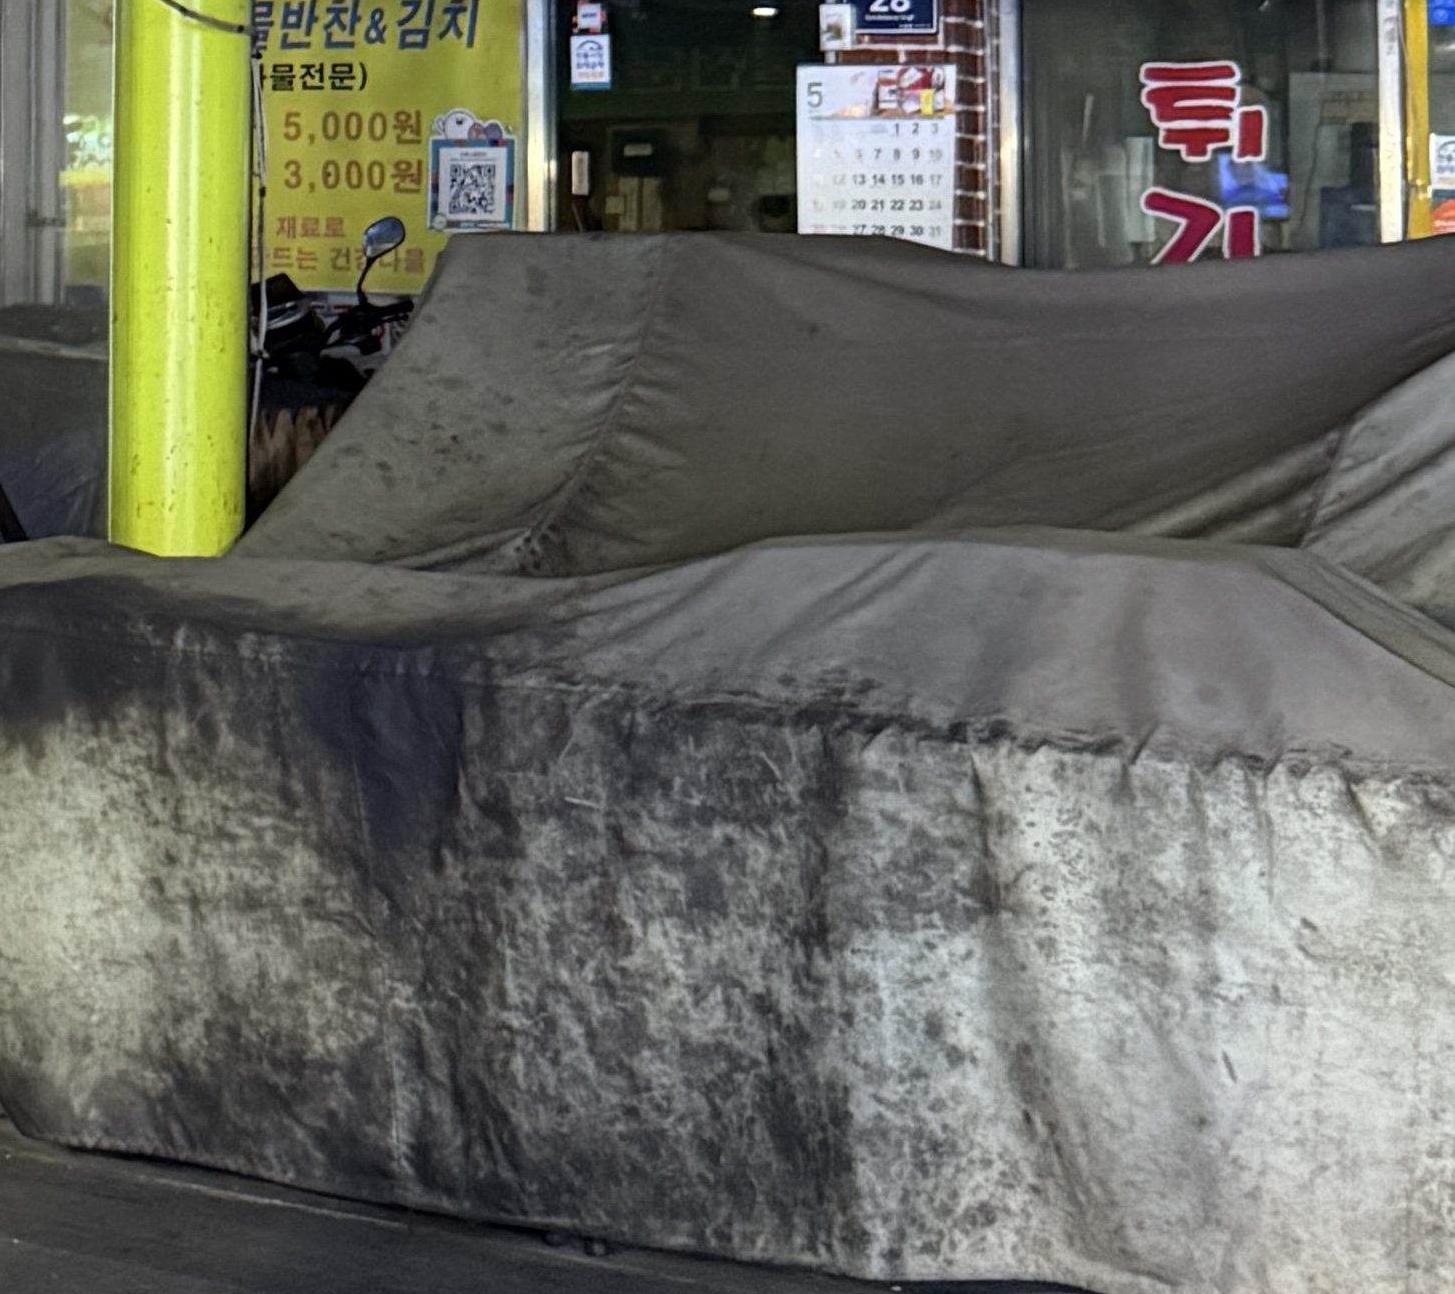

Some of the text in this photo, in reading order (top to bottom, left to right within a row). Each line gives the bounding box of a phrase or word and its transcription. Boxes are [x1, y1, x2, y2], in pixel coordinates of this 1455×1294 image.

[255, 62, 369, 93] 물전문)
[807, 82, 824, 108] 5
[282, 110, 424, 146] 5,000원
[282, 158, 424, 196] 3,000원
